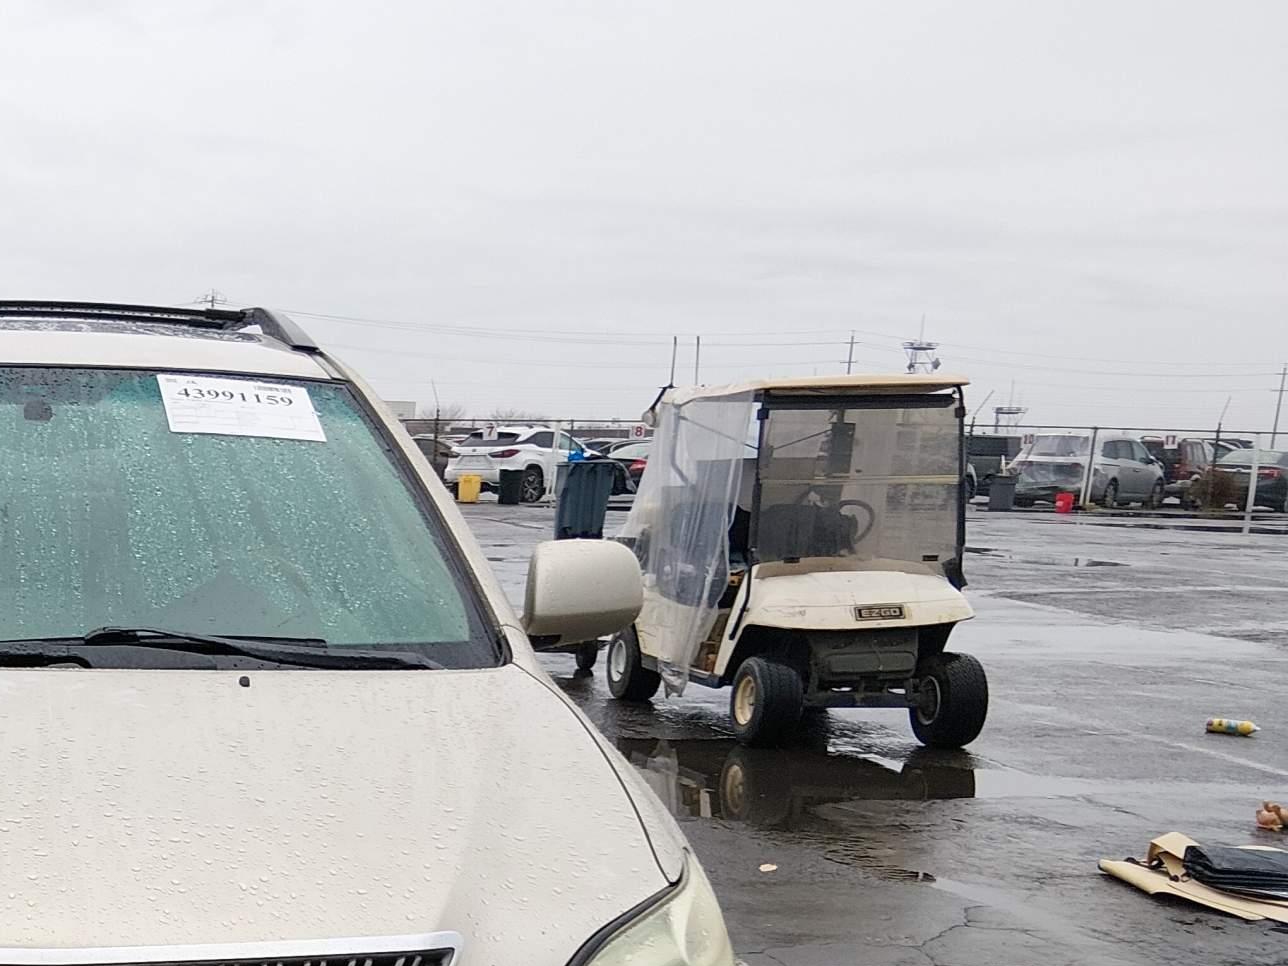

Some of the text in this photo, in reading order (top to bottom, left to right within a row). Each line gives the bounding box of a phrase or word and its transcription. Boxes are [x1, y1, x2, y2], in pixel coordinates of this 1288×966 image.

[176, 387, 294, 407] 43991159
[486, 425, 496, 437] 7
[634, 426, 644, 437] 8
[860, 607, 901, 618] EZGO
